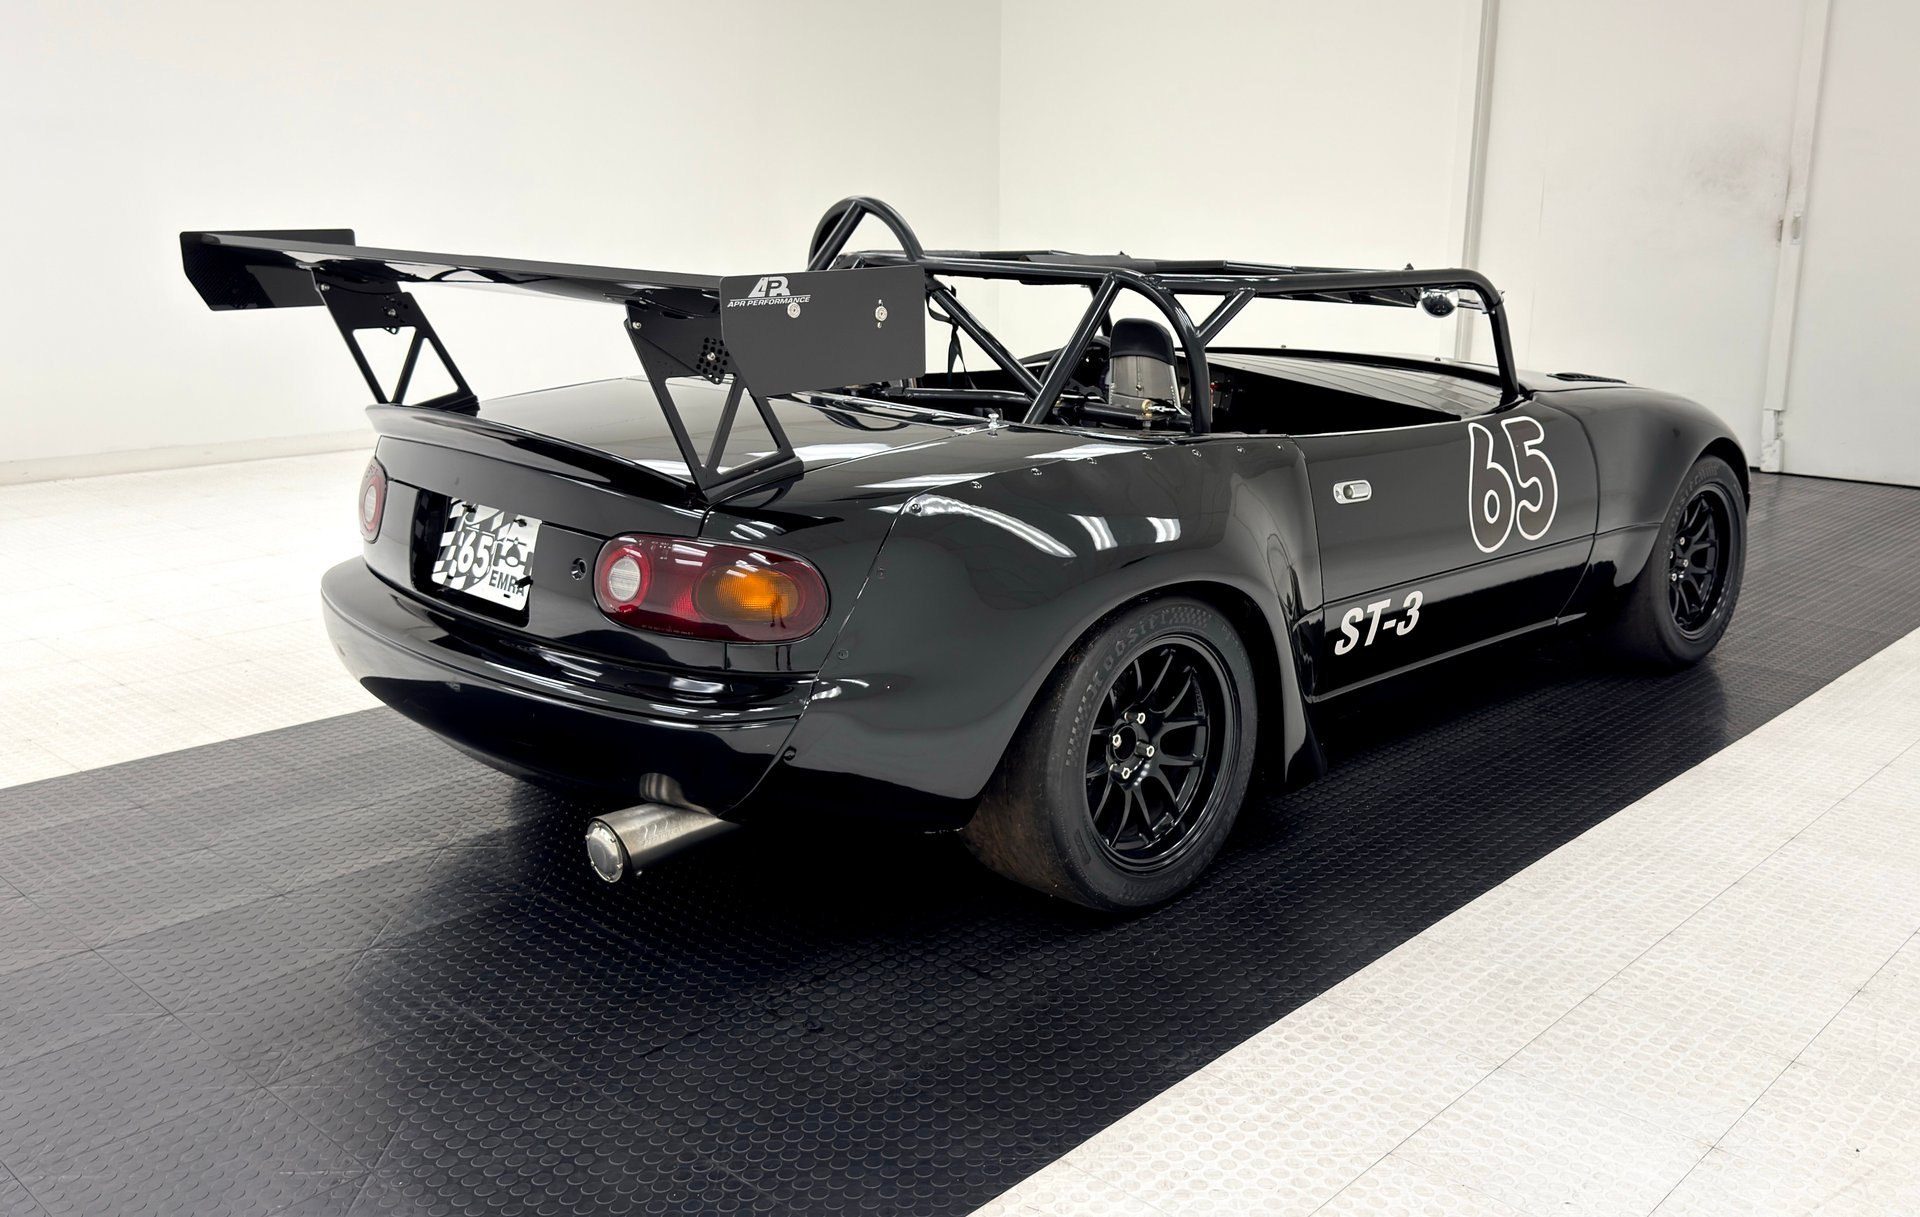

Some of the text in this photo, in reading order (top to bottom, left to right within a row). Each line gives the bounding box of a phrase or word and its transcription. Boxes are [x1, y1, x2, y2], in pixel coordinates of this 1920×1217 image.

[727, 296, 811, 308] APR PERFORMANCE
[748, 276, 791, 298] APR
[1468, 416, 1559, 553] 65
[1334, 590, 1424, 656] ST-3
